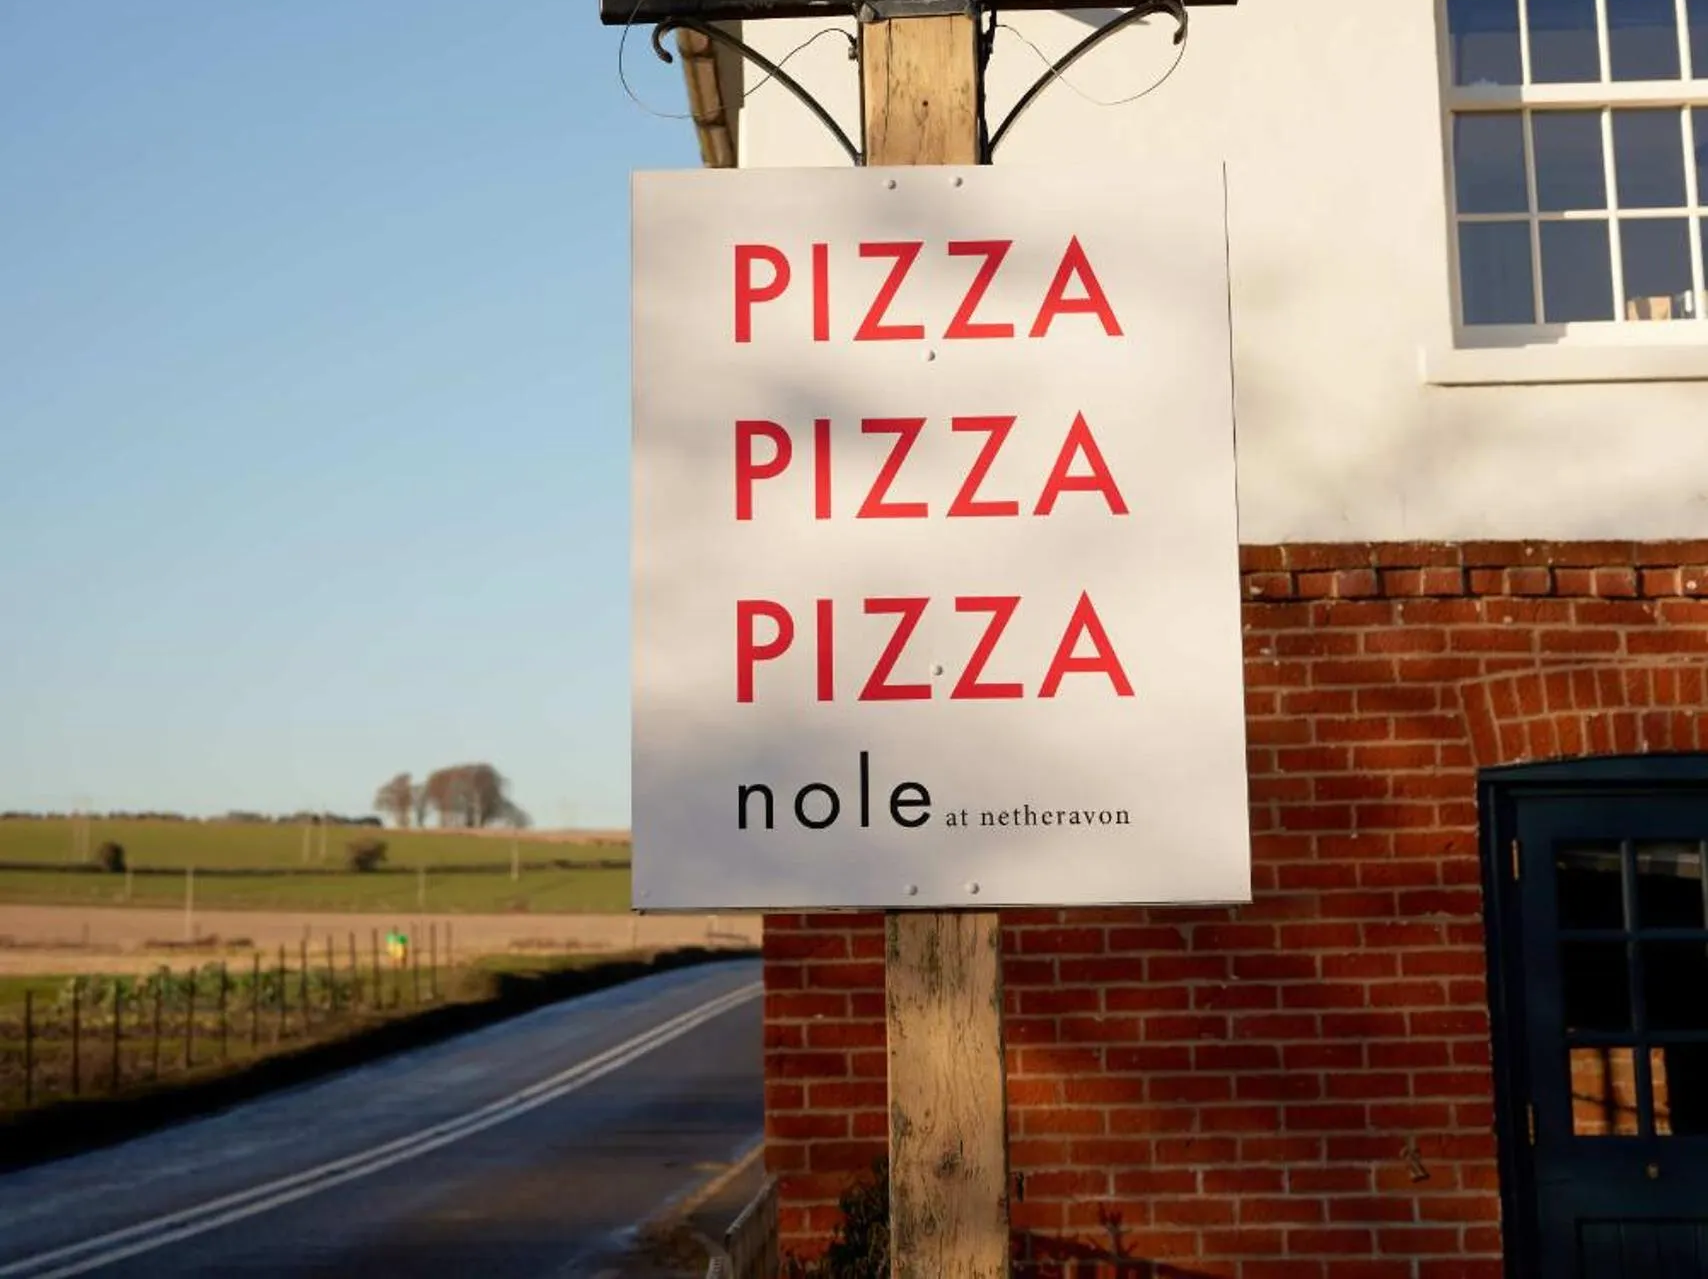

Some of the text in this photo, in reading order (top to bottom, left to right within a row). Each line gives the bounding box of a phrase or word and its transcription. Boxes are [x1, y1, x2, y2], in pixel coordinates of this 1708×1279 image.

[733, 235, 1124, 345] PIZZA
[734, 411, 1130, 522] PIZZA
[735, 591, 1136, 705] PIZZA
[737, 750, 1131, 831] nole at netheravon
